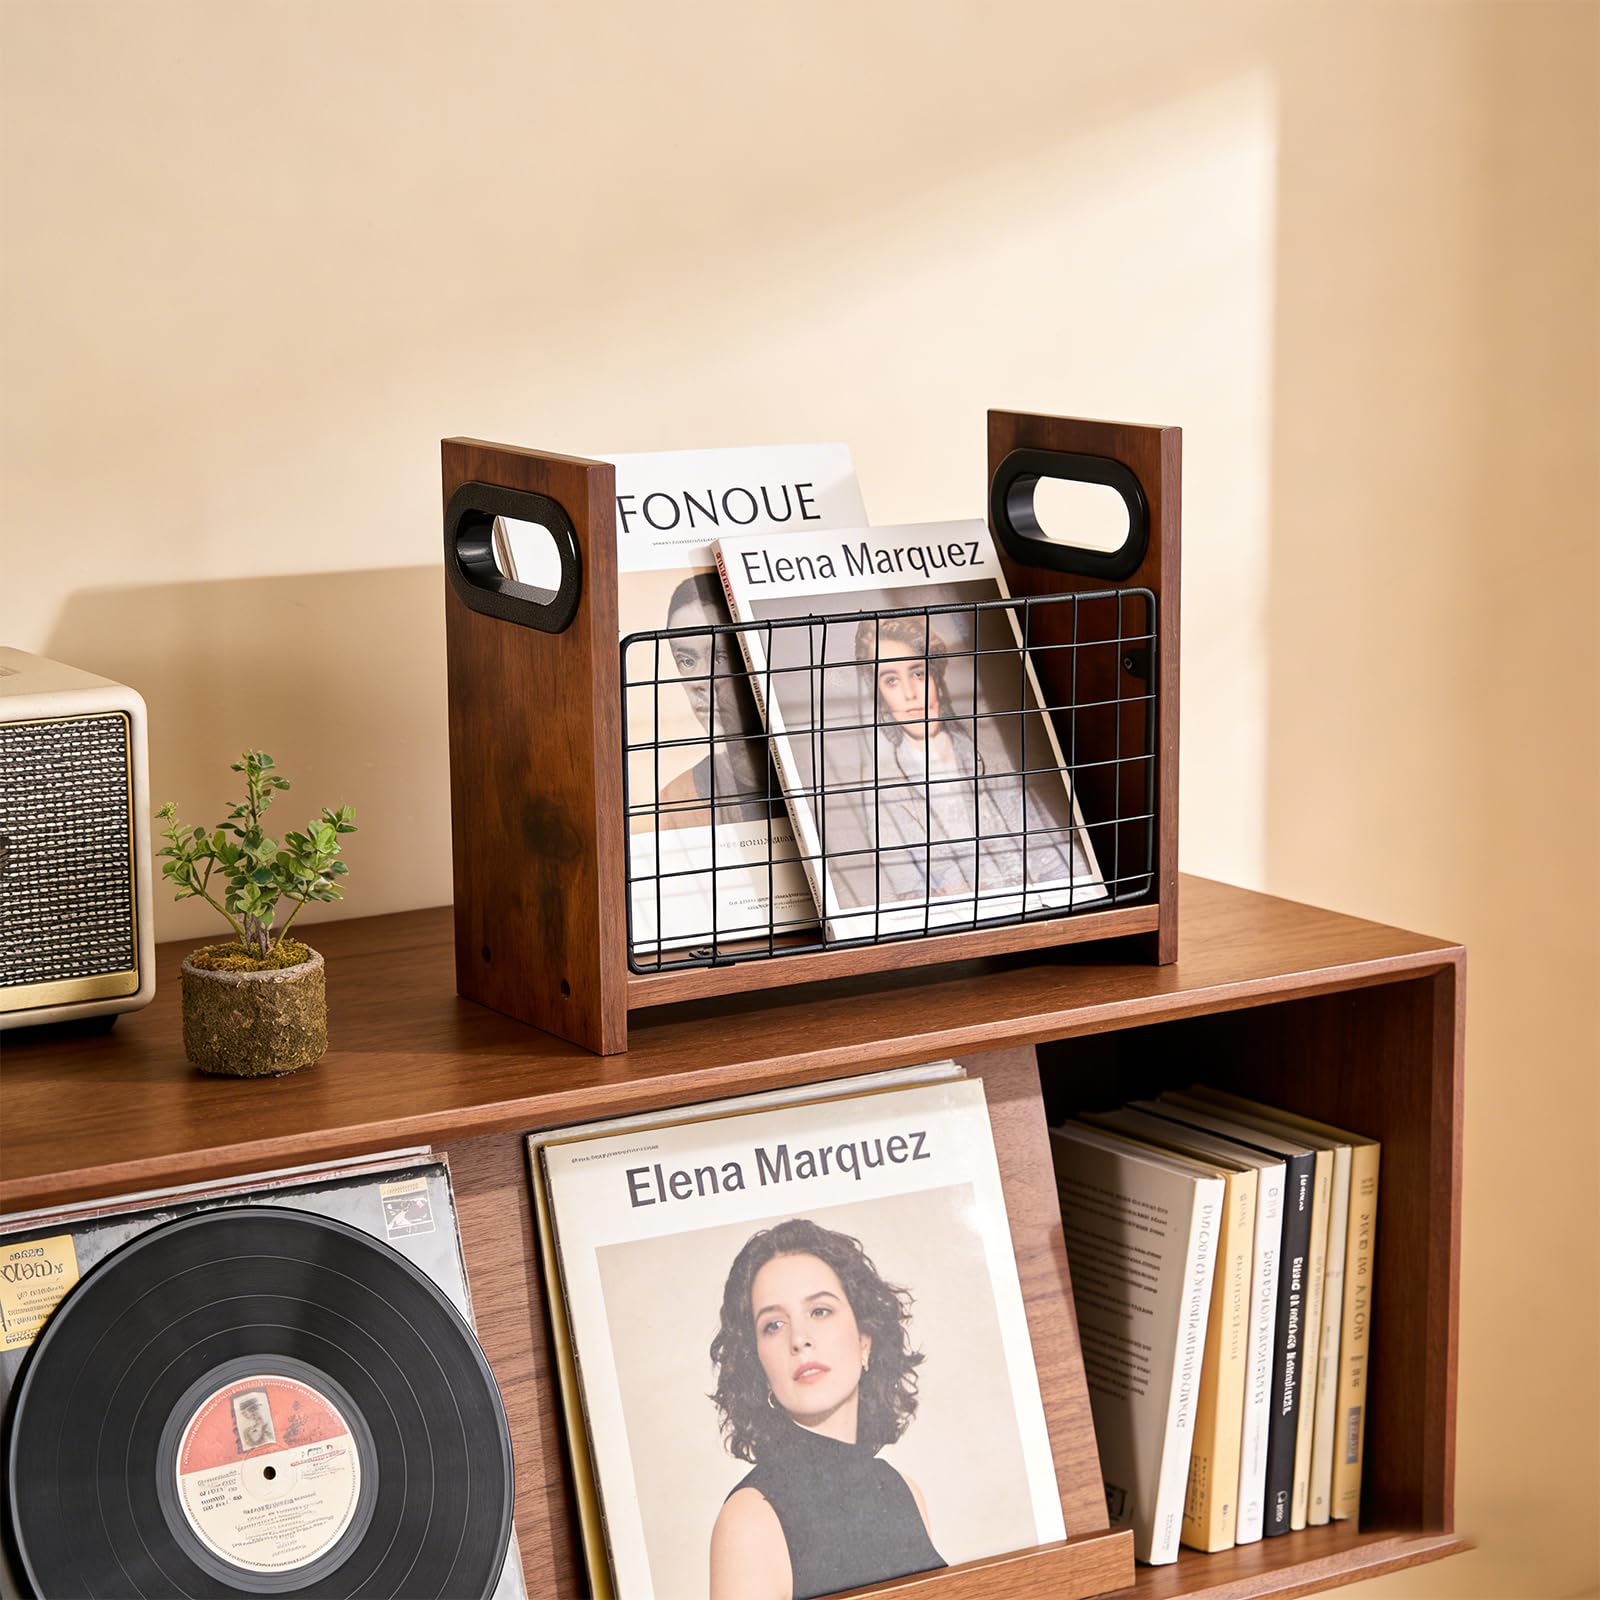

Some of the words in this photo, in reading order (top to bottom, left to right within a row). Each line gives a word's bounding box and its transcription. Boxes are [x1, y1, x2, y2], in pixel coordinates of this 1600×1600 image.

[616, 482, 821, 534] FONOUE
[741, 550, 836, 584] Elena
[842, 541, 985, 577] Marquez
[626, 1162, 746, 1208] Elena
[754, 1130, 931, 1186] Marquez
